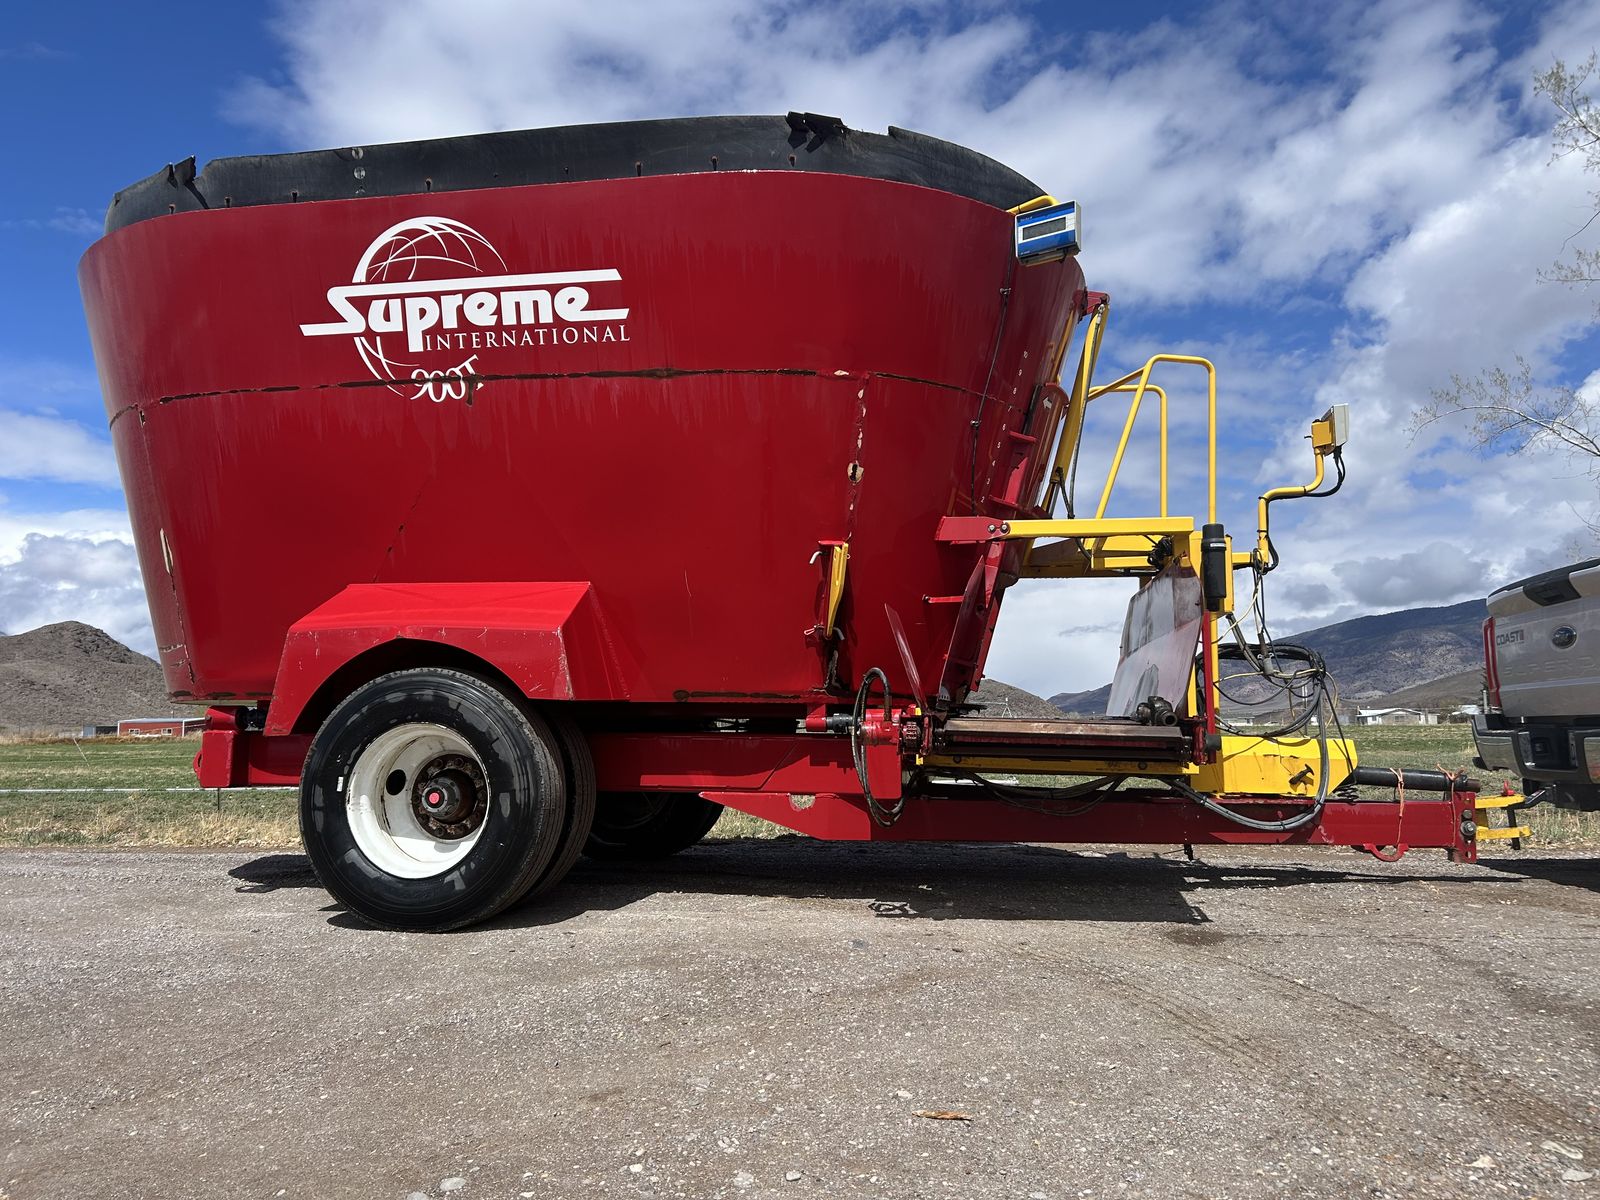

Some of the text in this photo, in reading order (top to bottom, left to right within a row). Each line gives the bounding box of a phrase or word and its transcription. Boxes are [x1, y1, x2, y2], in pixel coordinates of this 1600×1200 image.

[299, 269, 630, 352] Supreme
[425, 324, 630, 351] INTERNATIONAL
[409, 354, 484, 403] 900T
